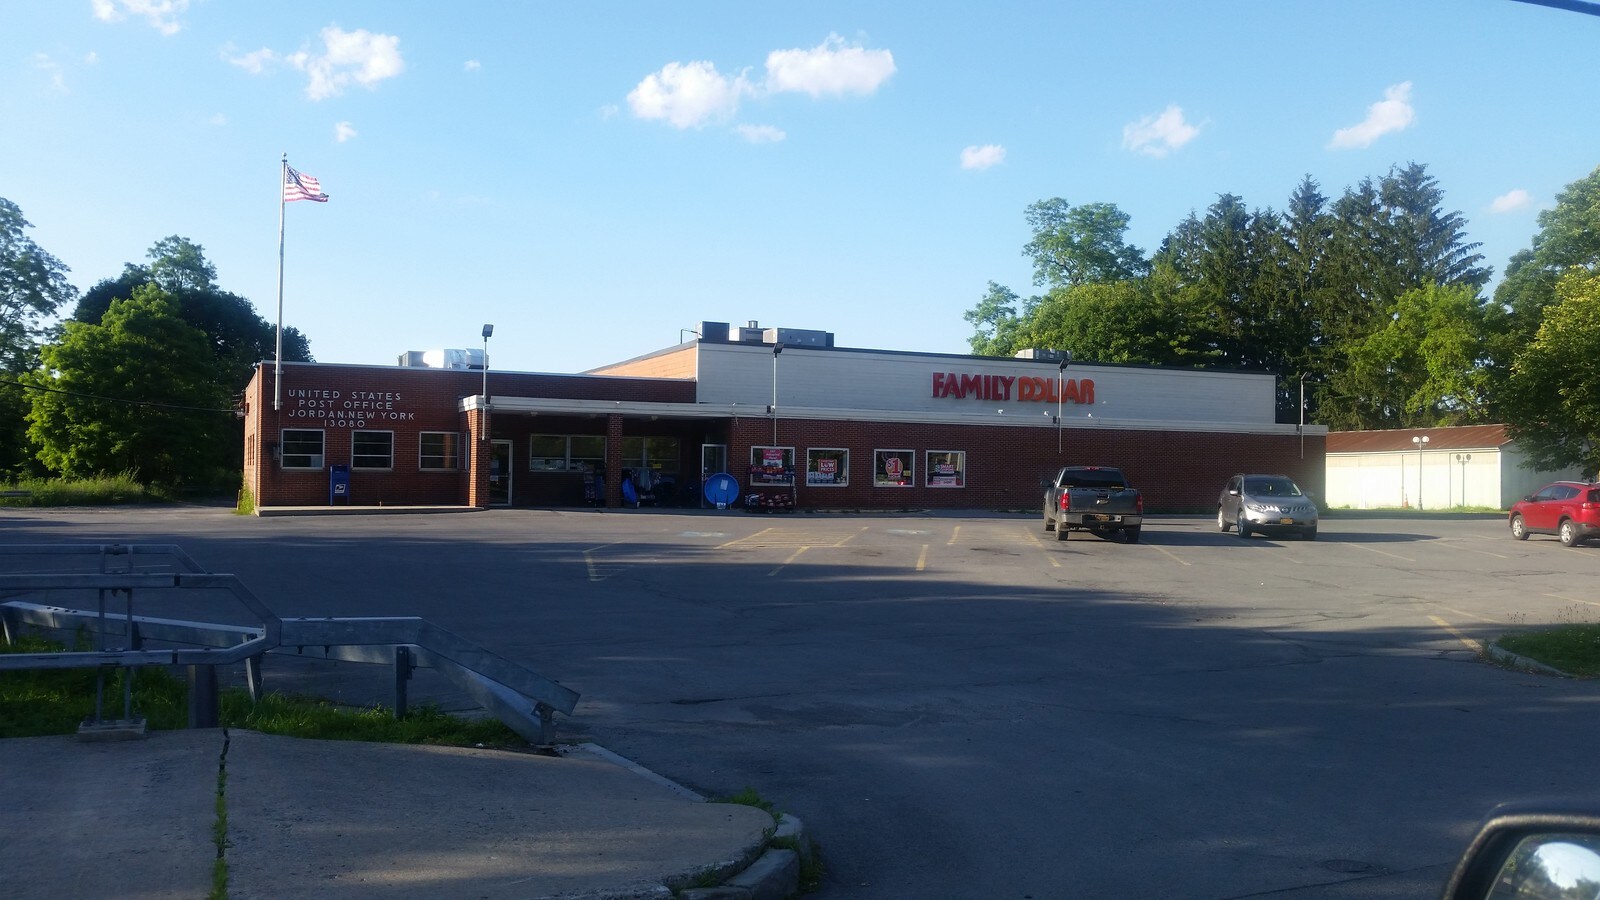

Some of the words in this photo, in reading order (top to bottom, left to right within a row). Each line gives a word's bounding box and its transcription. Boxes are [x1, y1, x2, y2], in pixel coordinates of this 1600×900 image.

[932, 372, 1015, 401] FAMILY
[1017, 375, 1095, 404] DOLLAR
[288, 389, 340, 398] UNITED
[351, 391, 401, 400] STATES
[298, 400, 334, 408] POST
[343, 401, 393, 410] OFFICE
[381, 412, 415, 420] YORK
[324, 420, 365, 428] 13080
